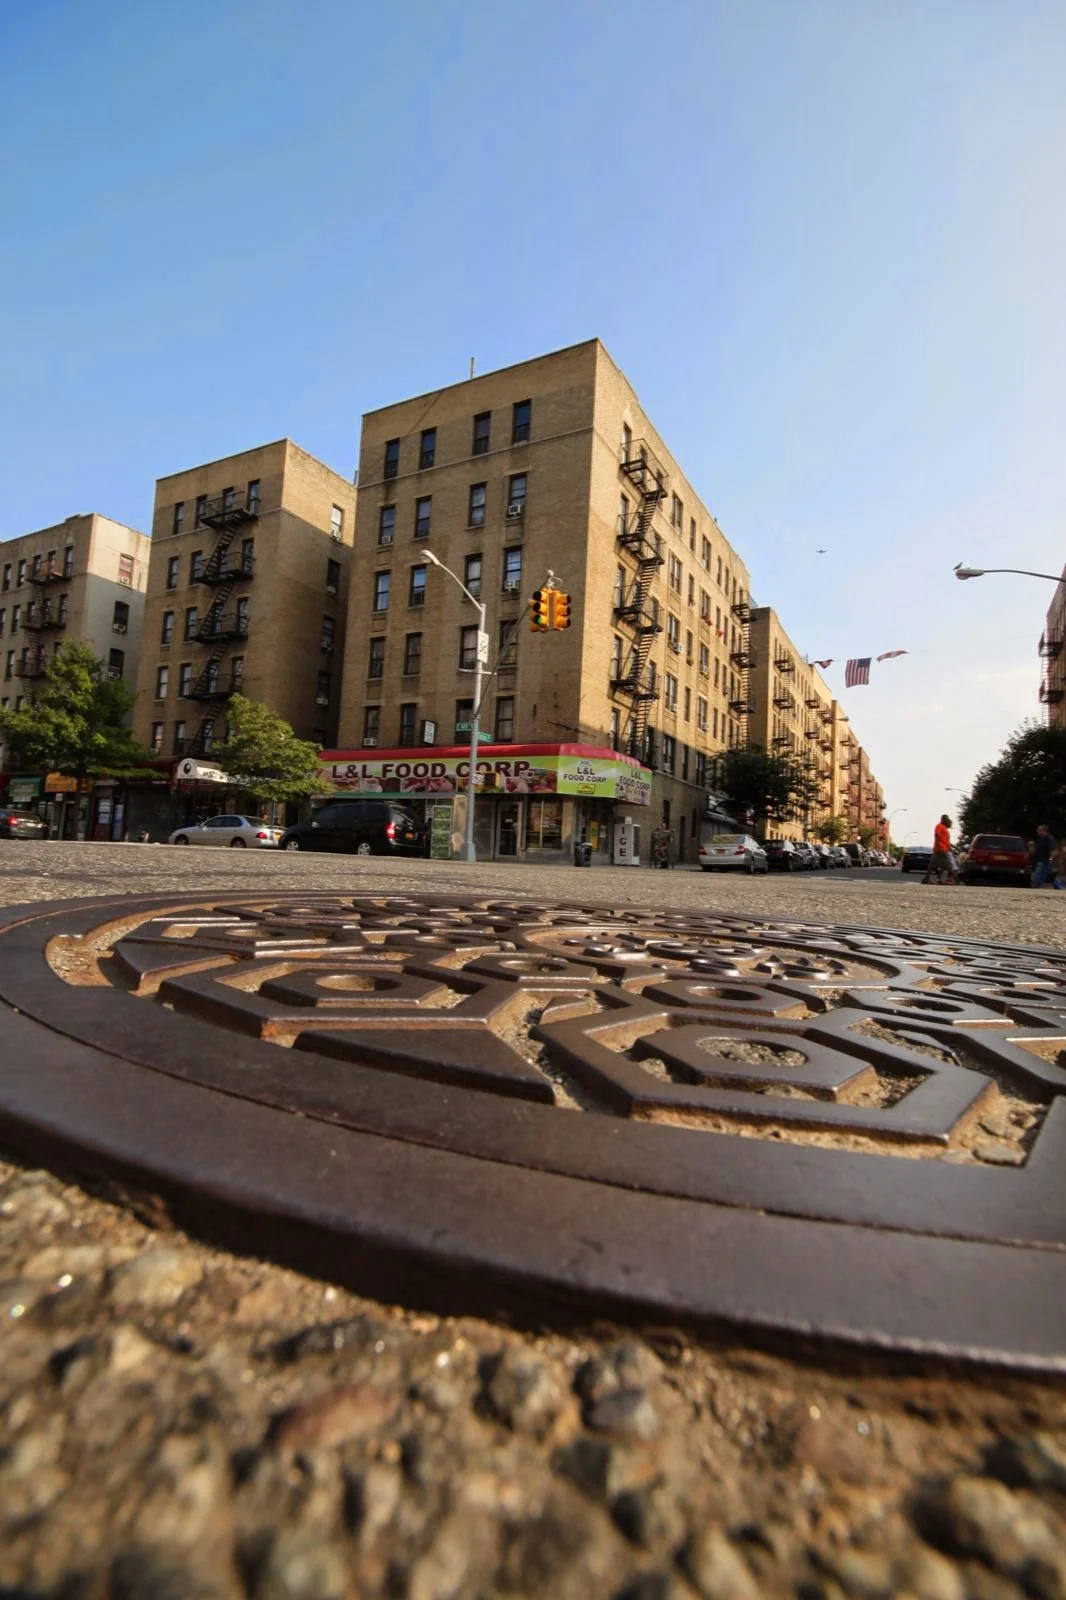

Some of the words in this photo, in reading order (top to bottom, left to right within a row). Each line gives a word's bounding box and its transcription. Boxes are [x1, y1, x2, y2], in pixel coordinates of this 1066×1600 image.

[332, 764, 373, 779] L&L
[382, 762, 446, 779] FOOD
[456, 760, 534, 778] CORP.
[577, 767, 595, 775] L&L
[630, 769, 642, 780] L&L
[563, 774, 585, 782] FOOD
[620, 776, 635, 787] FOOD
[619, 827, 627, 857] ICE
